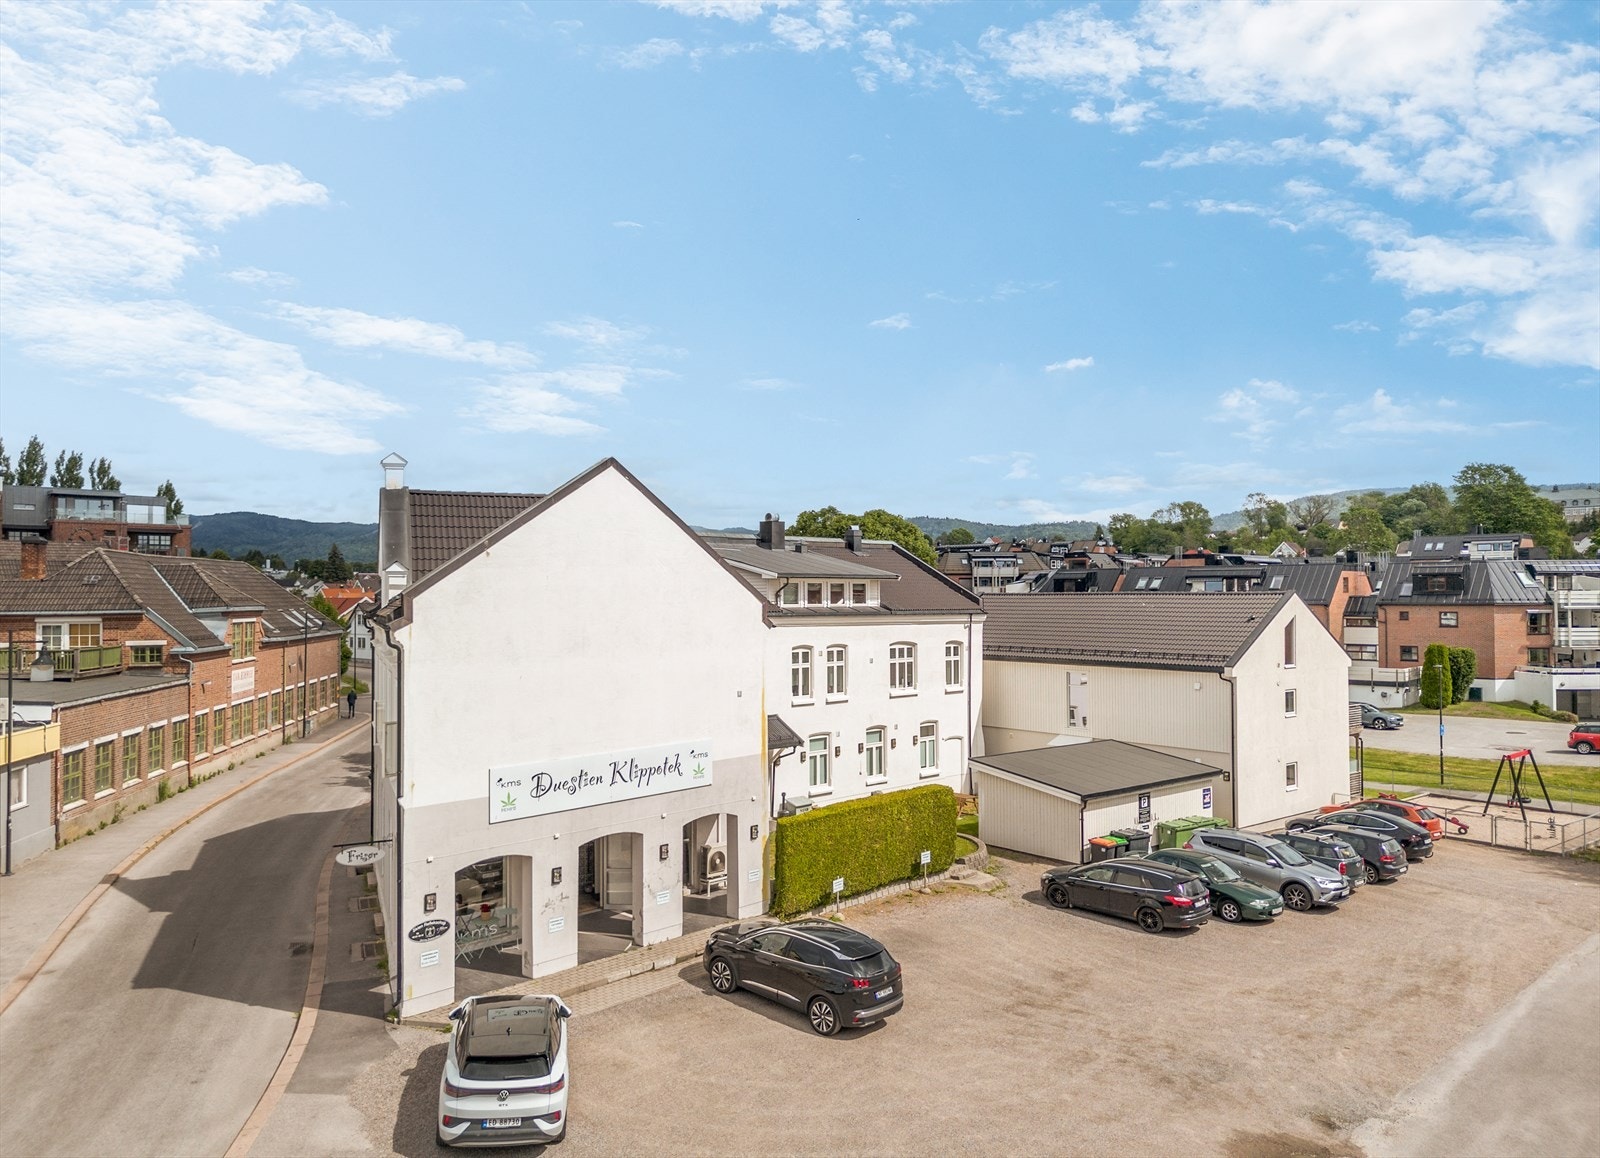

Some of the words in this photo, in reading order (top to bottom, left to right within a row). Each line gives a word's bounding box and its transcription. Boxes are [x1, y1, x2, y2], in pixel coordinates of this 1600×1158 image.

[692, 751, 709, 759] kms
[529, 769, 604, 801] Duestien
[609, 753, 683, 787] Klippotek
[501, 779, 522, 788] kms
